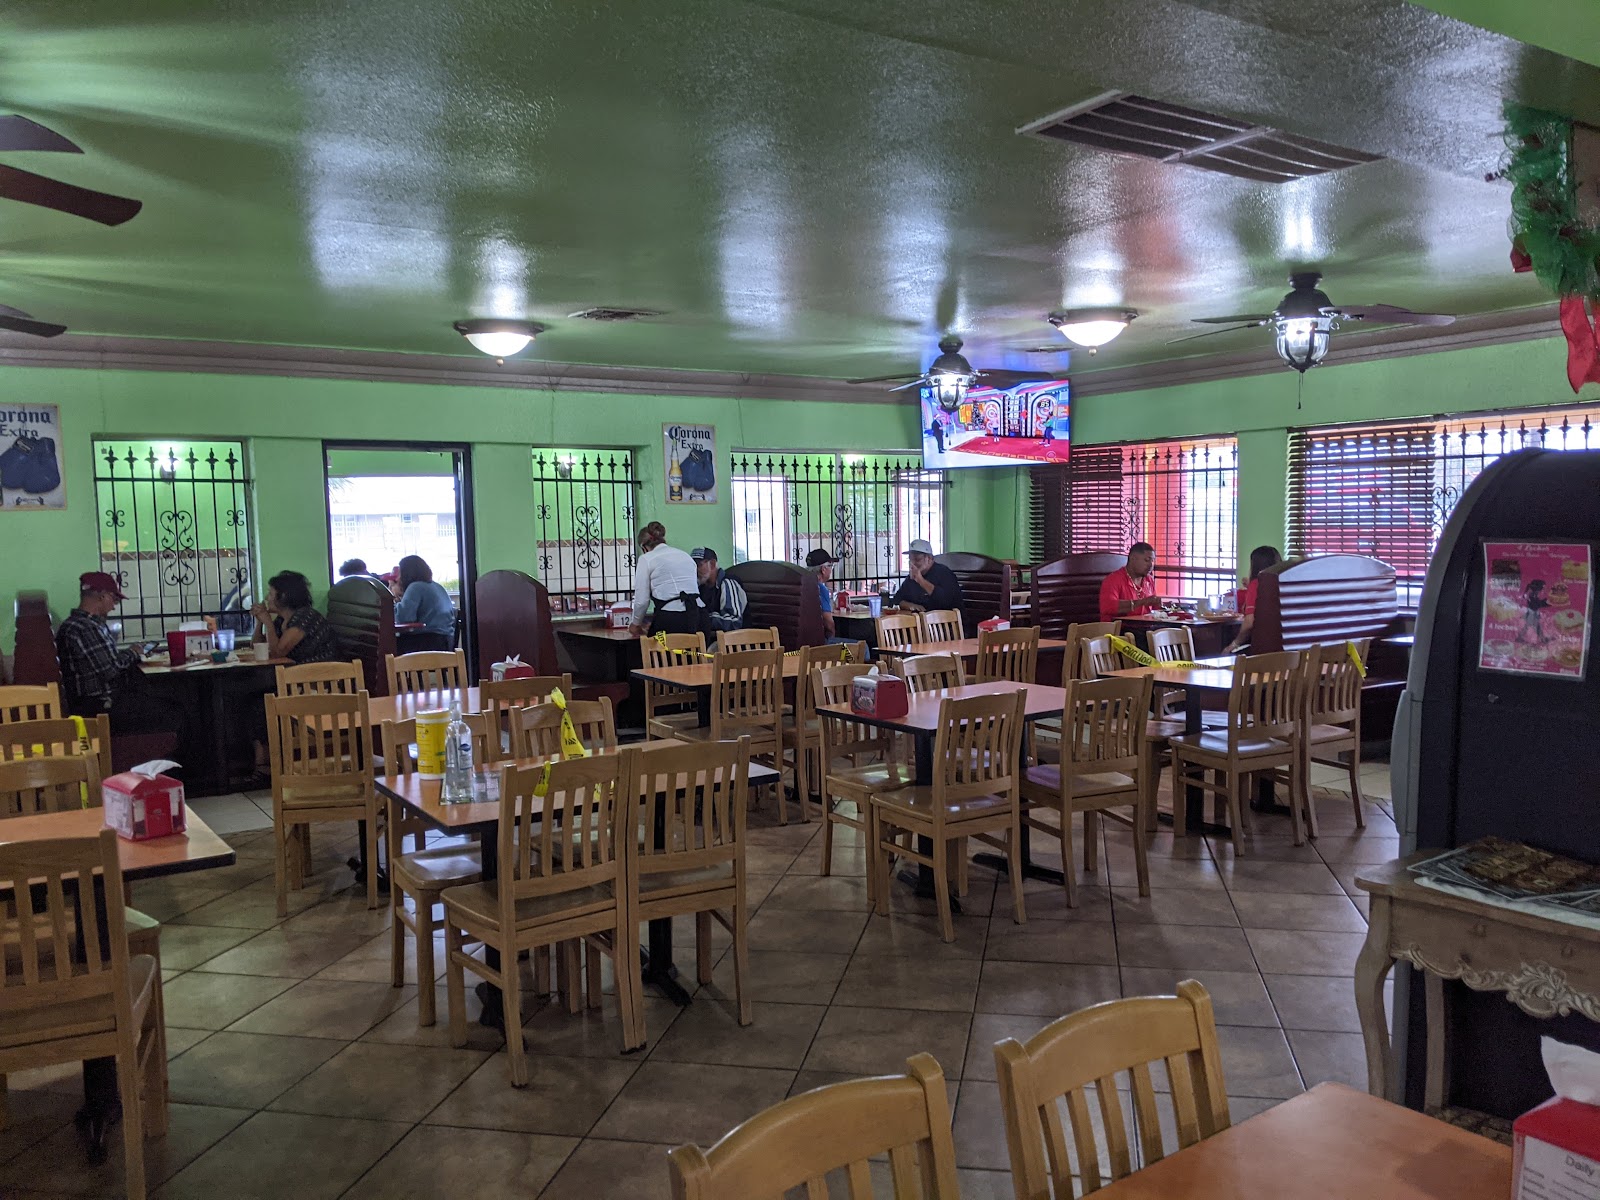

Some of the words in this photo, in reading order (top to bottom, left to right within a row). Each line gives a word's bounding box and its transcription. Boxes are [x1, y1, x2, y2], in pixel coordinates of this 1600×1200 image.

[0, 410, 52, 424] orona
[0, 424, 39, 437] Extra
[668, 426, 712, 441] Corona
[681, 440, 704, 450] Extra
[621, 616, 630, 626] 12
[197, 640, 209, 651] 11
[1565, 1155, 1596, 1177] Daily
